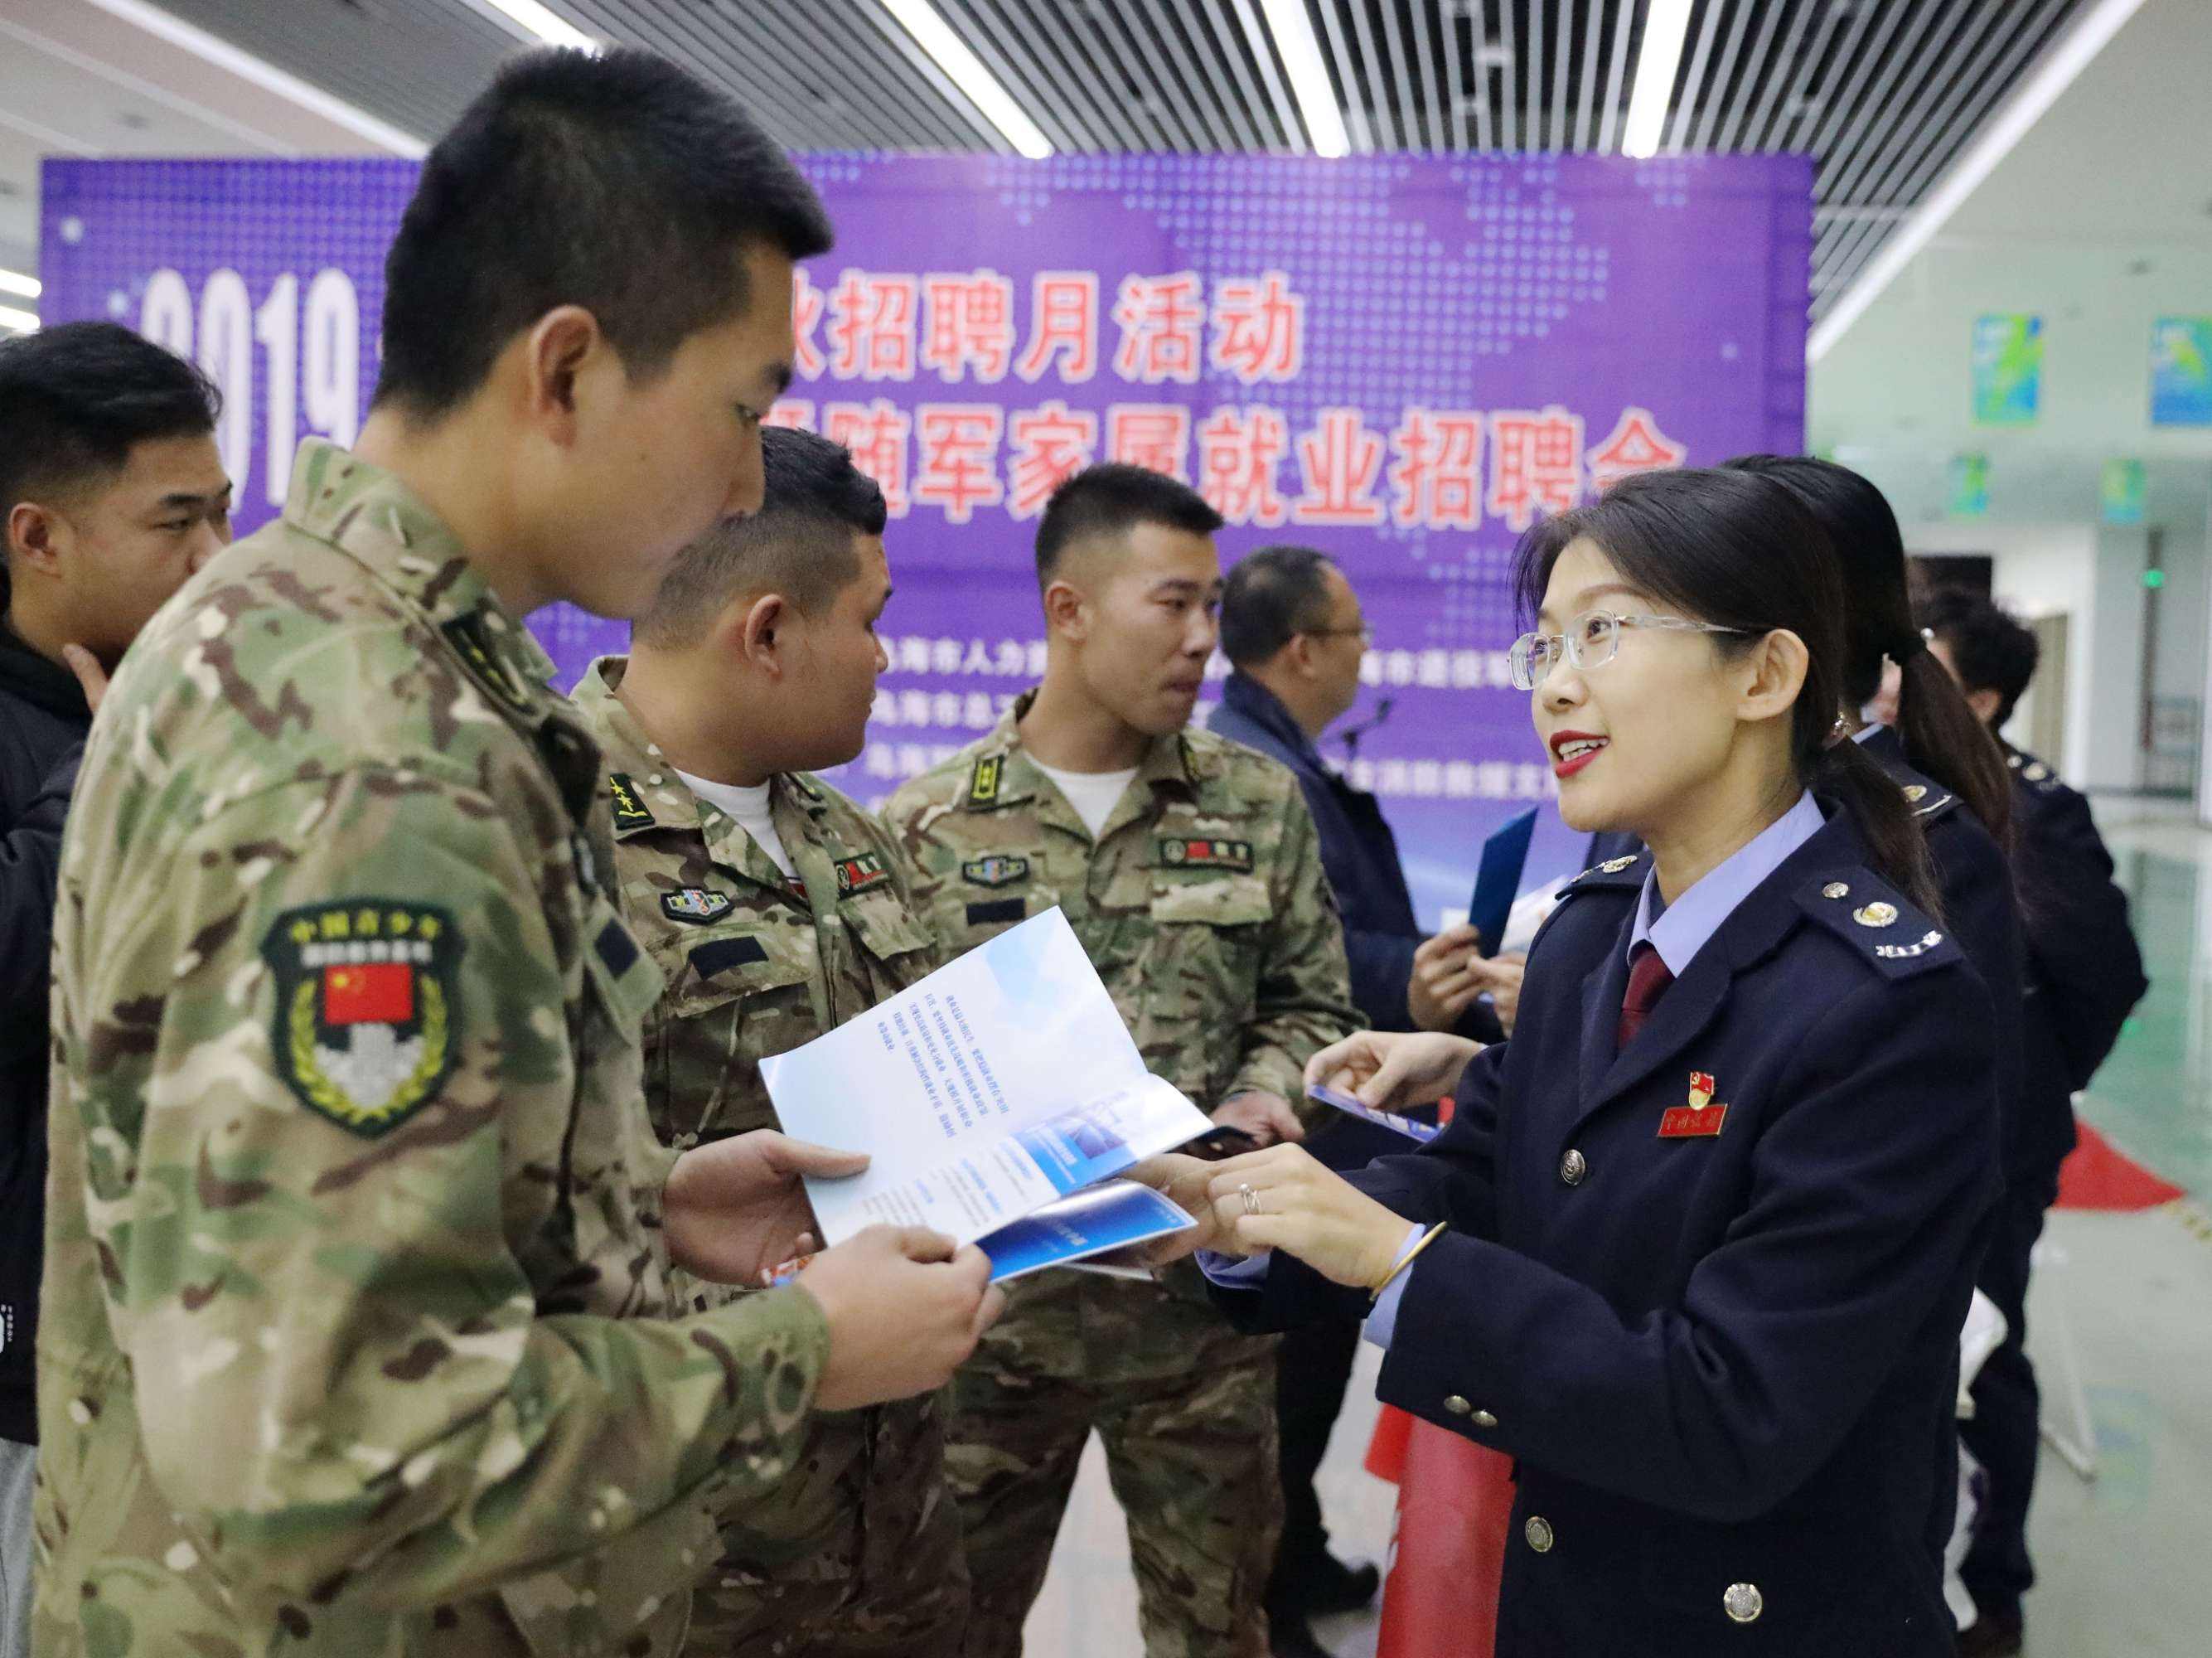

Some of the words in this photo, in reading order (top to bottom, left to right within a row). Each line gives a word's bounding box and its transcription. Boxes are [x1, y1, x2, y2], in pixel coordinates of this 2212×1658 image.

[760, 398, 1688, 533] 随军家属就业招聘会
